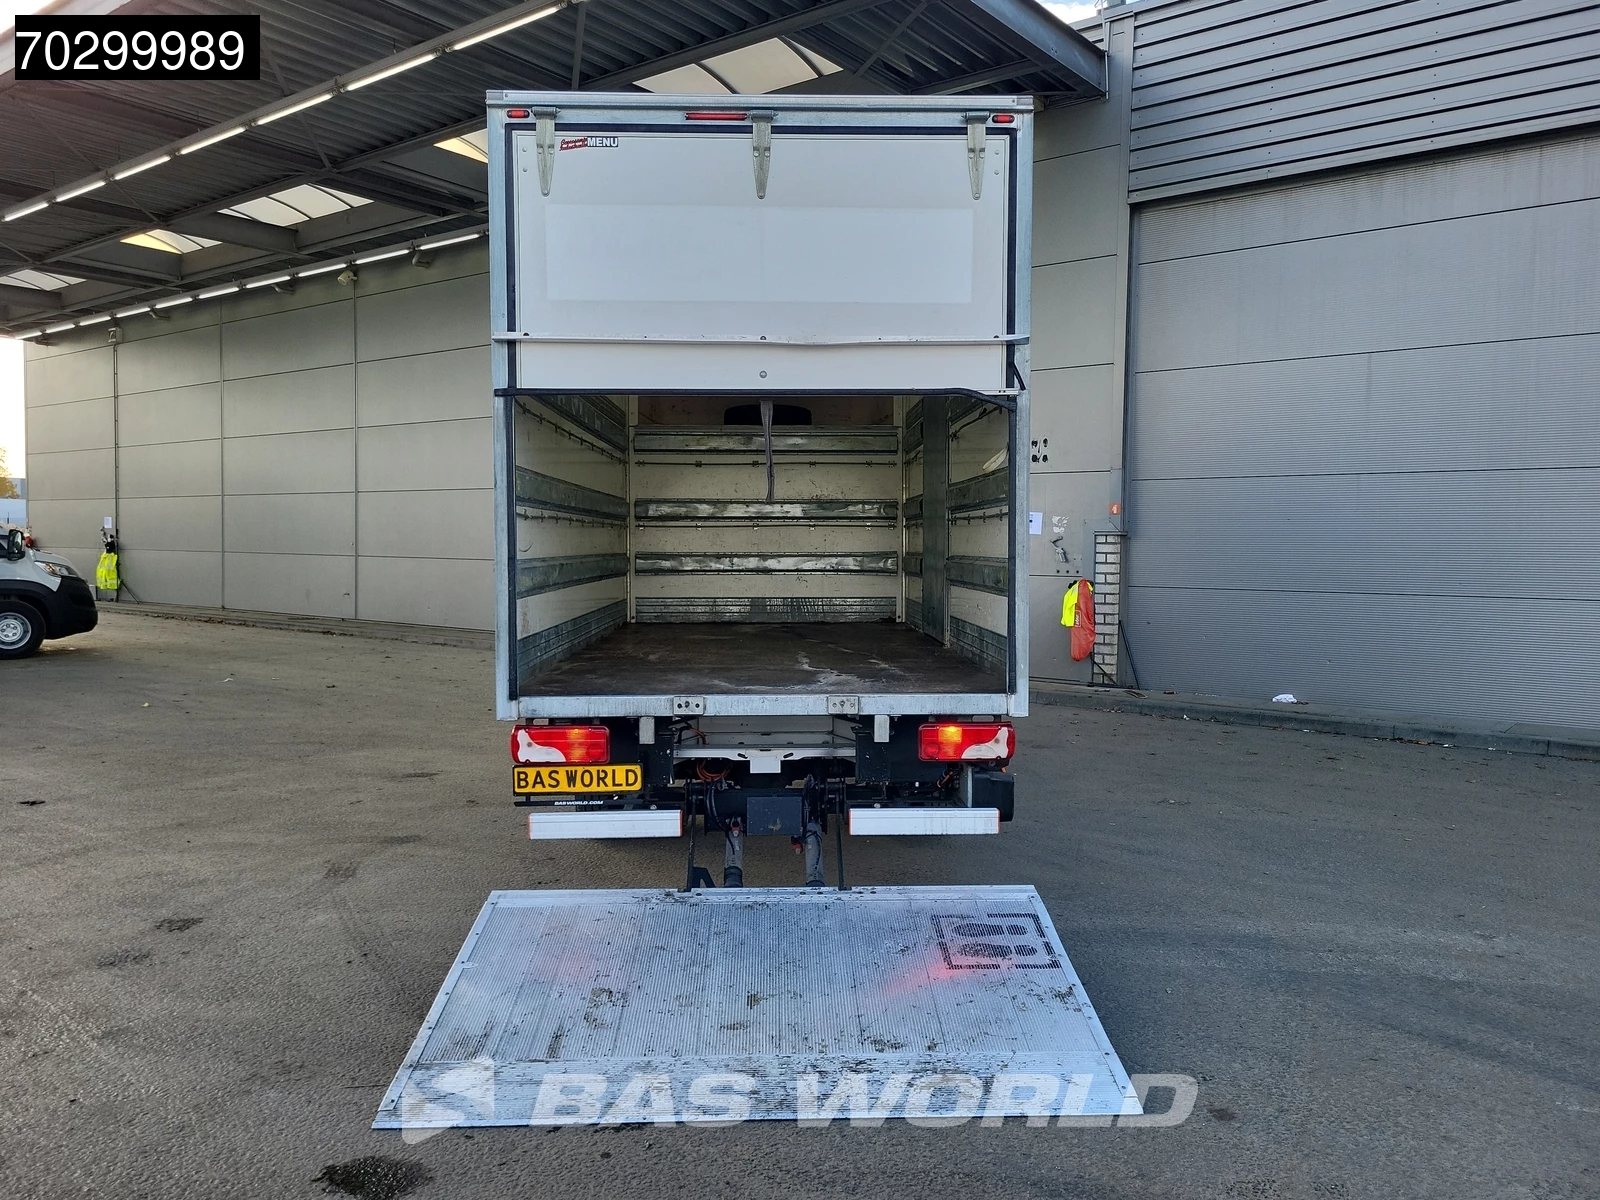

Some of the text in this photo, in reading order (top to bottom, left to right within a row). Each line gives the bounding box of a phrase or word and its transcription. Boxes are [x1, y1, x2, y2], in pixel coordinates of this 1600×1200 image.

[587, 137, 618, 147] MENU
[516, 769, 639, 789] BAS WORLD
